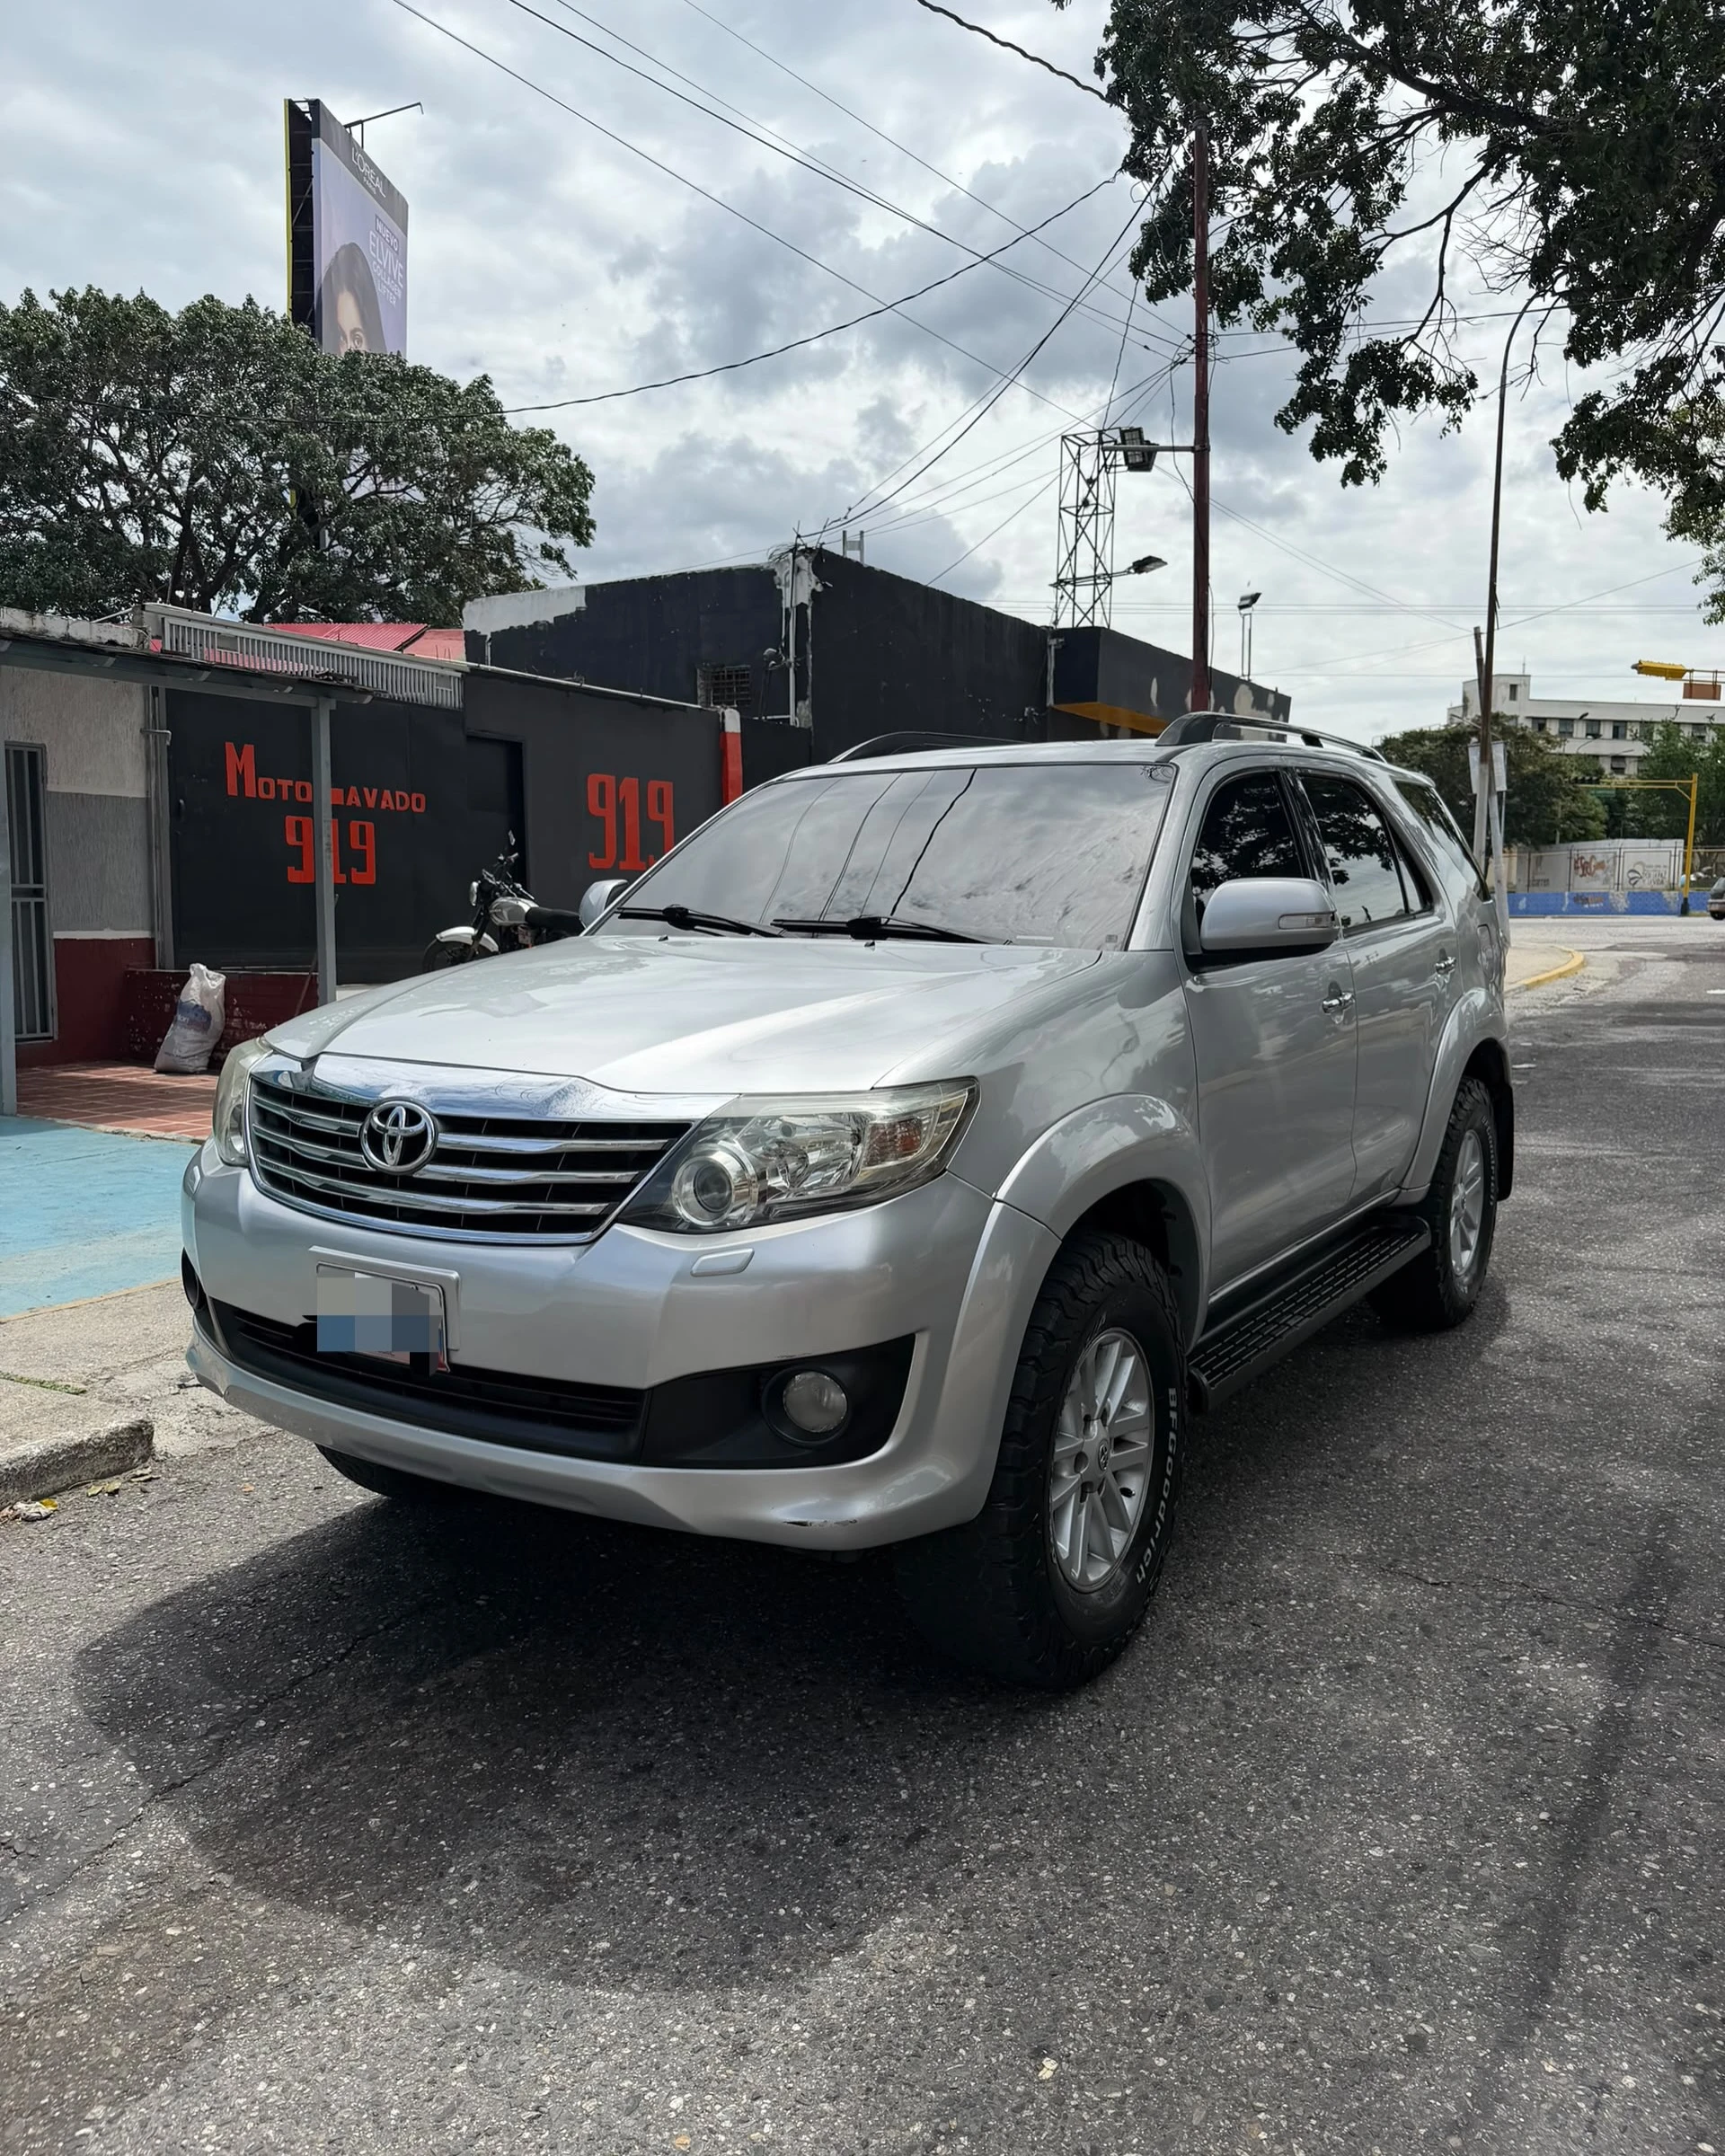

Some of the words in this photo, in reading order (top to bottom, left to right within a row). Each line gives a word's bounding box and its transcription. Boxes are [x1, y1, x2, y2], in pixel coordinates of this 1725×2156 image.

[369, 230, 403, 288] ELVIVE
[376, 218, 399, 252] NUEVO
[377, 280, 396, 307] LIFTER
[588, 773, 675, 871] 919
[1137, 1388, 1178, 1585] BFGoodrich
